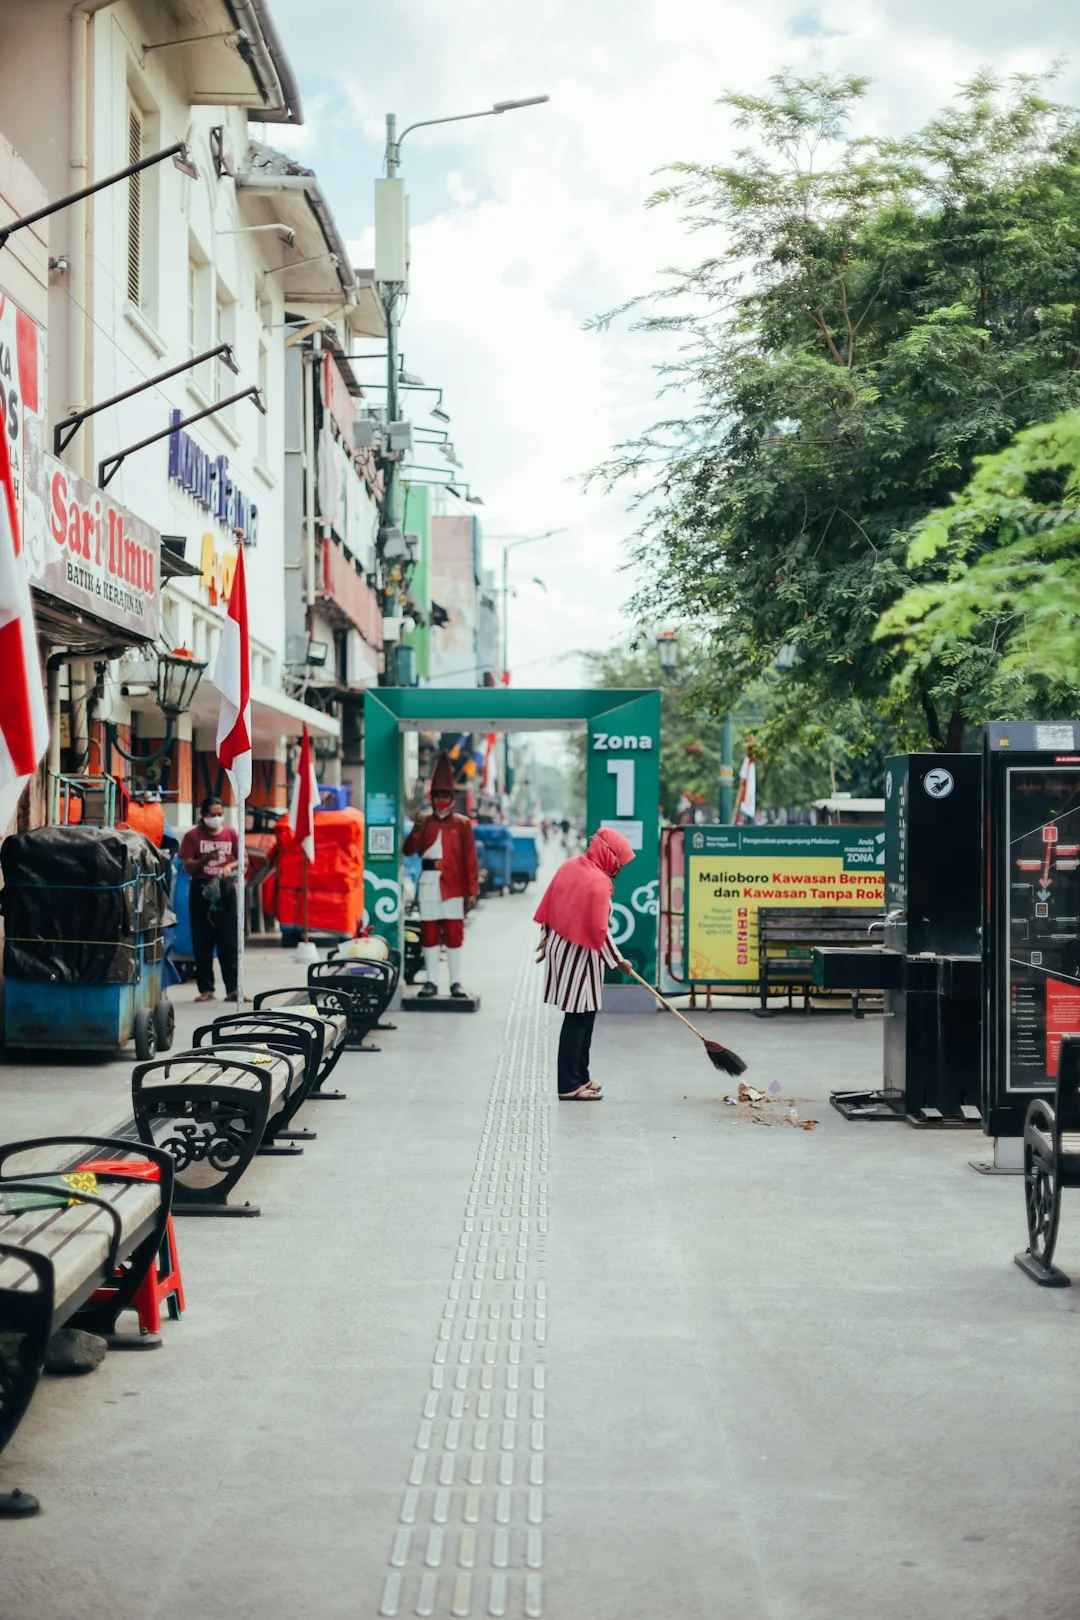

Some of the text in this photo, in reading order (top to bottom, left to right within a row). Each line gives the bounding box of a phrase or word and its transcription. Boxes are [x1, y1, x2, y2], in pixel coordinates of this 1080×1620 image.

[51, 470, 102, 566] Sari
[107, 508, 154, 595] Ilmu
[67, 562, 144, 617] BATIK & KERAJINAN
[593, 732, 653, 751] Zona
[606, 758, 637, 818] 1
[811, 837, 840, 845] Malioboro
[857, 838, 875, 846] Anda
[846, 853, 874, 863] ZONA
[699, 872, 769, 884] Malioboro
[772, 873, 836, 885] Kawasan
[713, 887, 740, 899] dan
[743, 888, 807, 899] Kawasan
[810, 889, 853, 902] Tanpa
